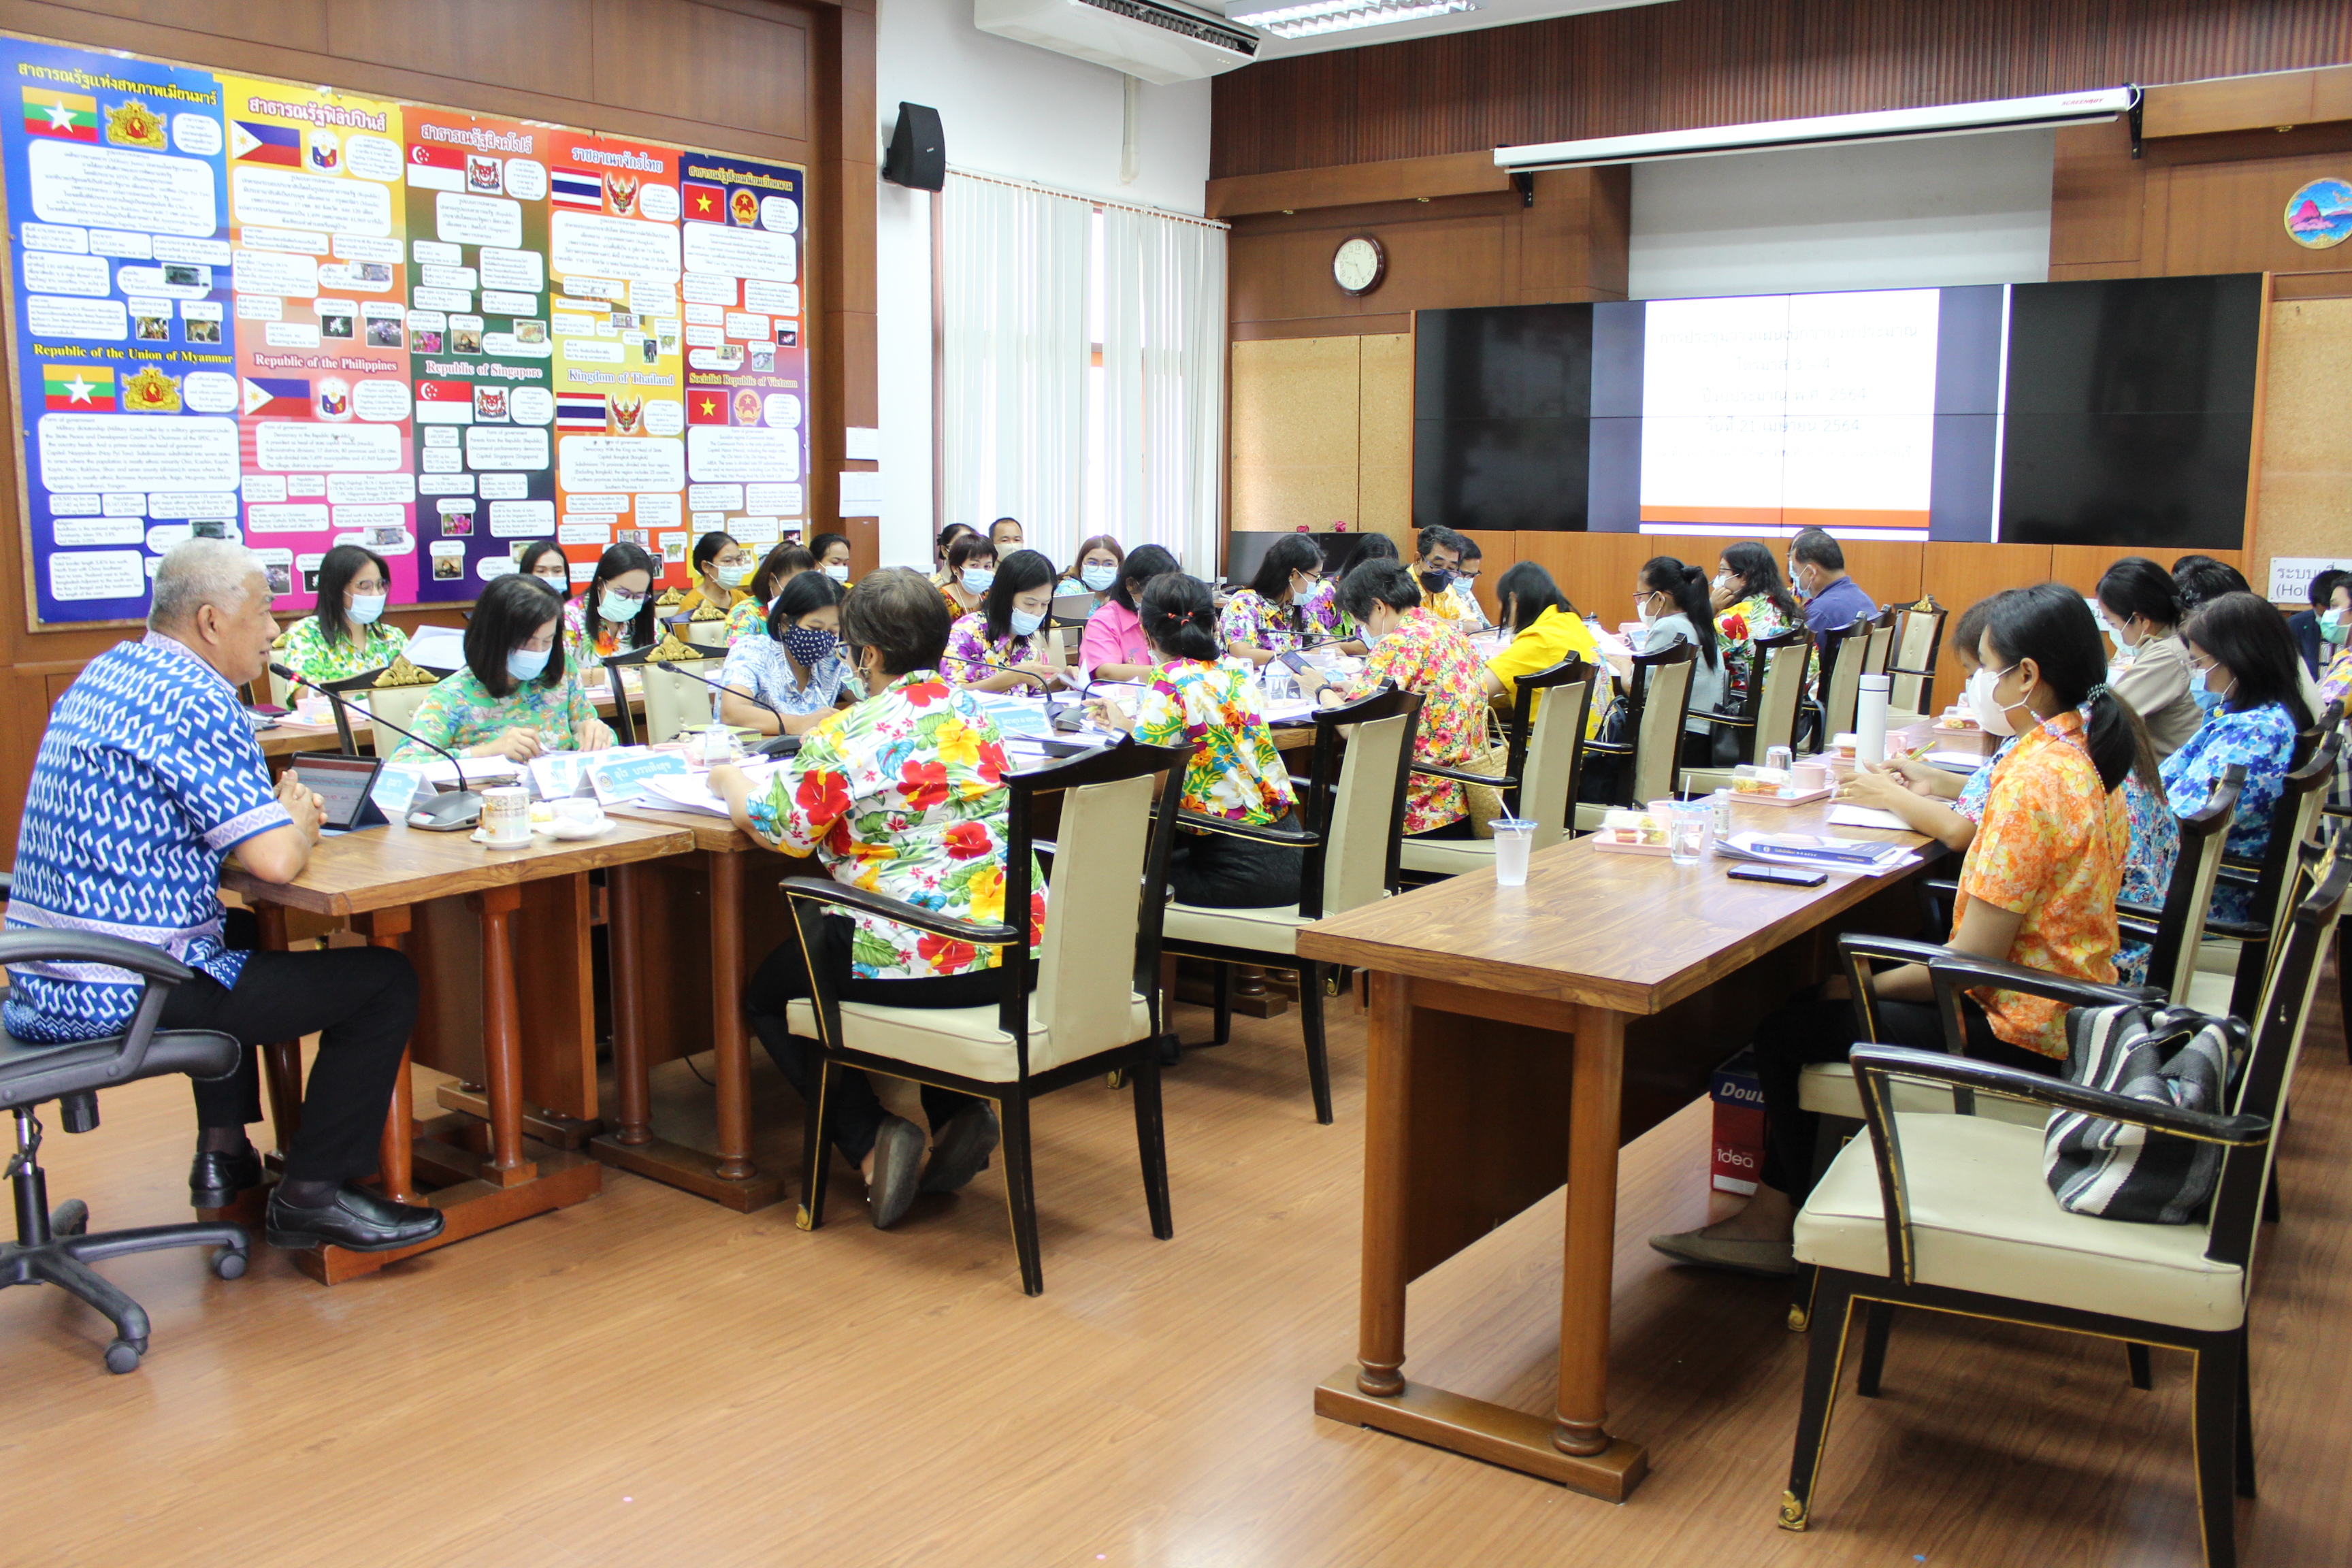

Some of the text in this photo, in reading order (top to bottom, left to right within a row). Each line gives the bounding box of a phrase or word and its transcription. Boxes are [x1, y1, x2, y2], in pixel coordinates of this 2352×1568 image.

[18, 63, 217, 105] สาธารณรัฐแห่งสหภาพเมียนมาร์
[248, 97, 387, 132] สาธารณรัฐฟิลิปปินส์
[421, 123, 533, 154] สาธารณรัฐสิงคโปร์
[572, 147, 664, 174] ราชอาณาจักรไทย
[33, 343, 233, 364] Republic of the Union of Myanmar
[255, 353, 397, 373] Republic of the Philippines
[425, 360, 542, 380] Republic of Singapore
[1736, 356, 1788, 372] ไตรมาส
[1794, 358, 1802, 371] 3
[1823, 357, 1831, 370] 4
[568, 368, 674, 386] Kingdom of Thailand
[689, 372, 798, 388] Socialist Republic of Vietnam
[1701, 386, 1786, 403] ปีงบประมาณ
[1830, 387, 1866, 401] 2564
[1740, 420, 1755, 432] 21
[1763, 419, 1816, 432] เมษายน
[1824, 419, 1860, 432] 2564
[2276, 583, 2308, 598] (Hol
[1717, 1149, 1754, 1169] idea
